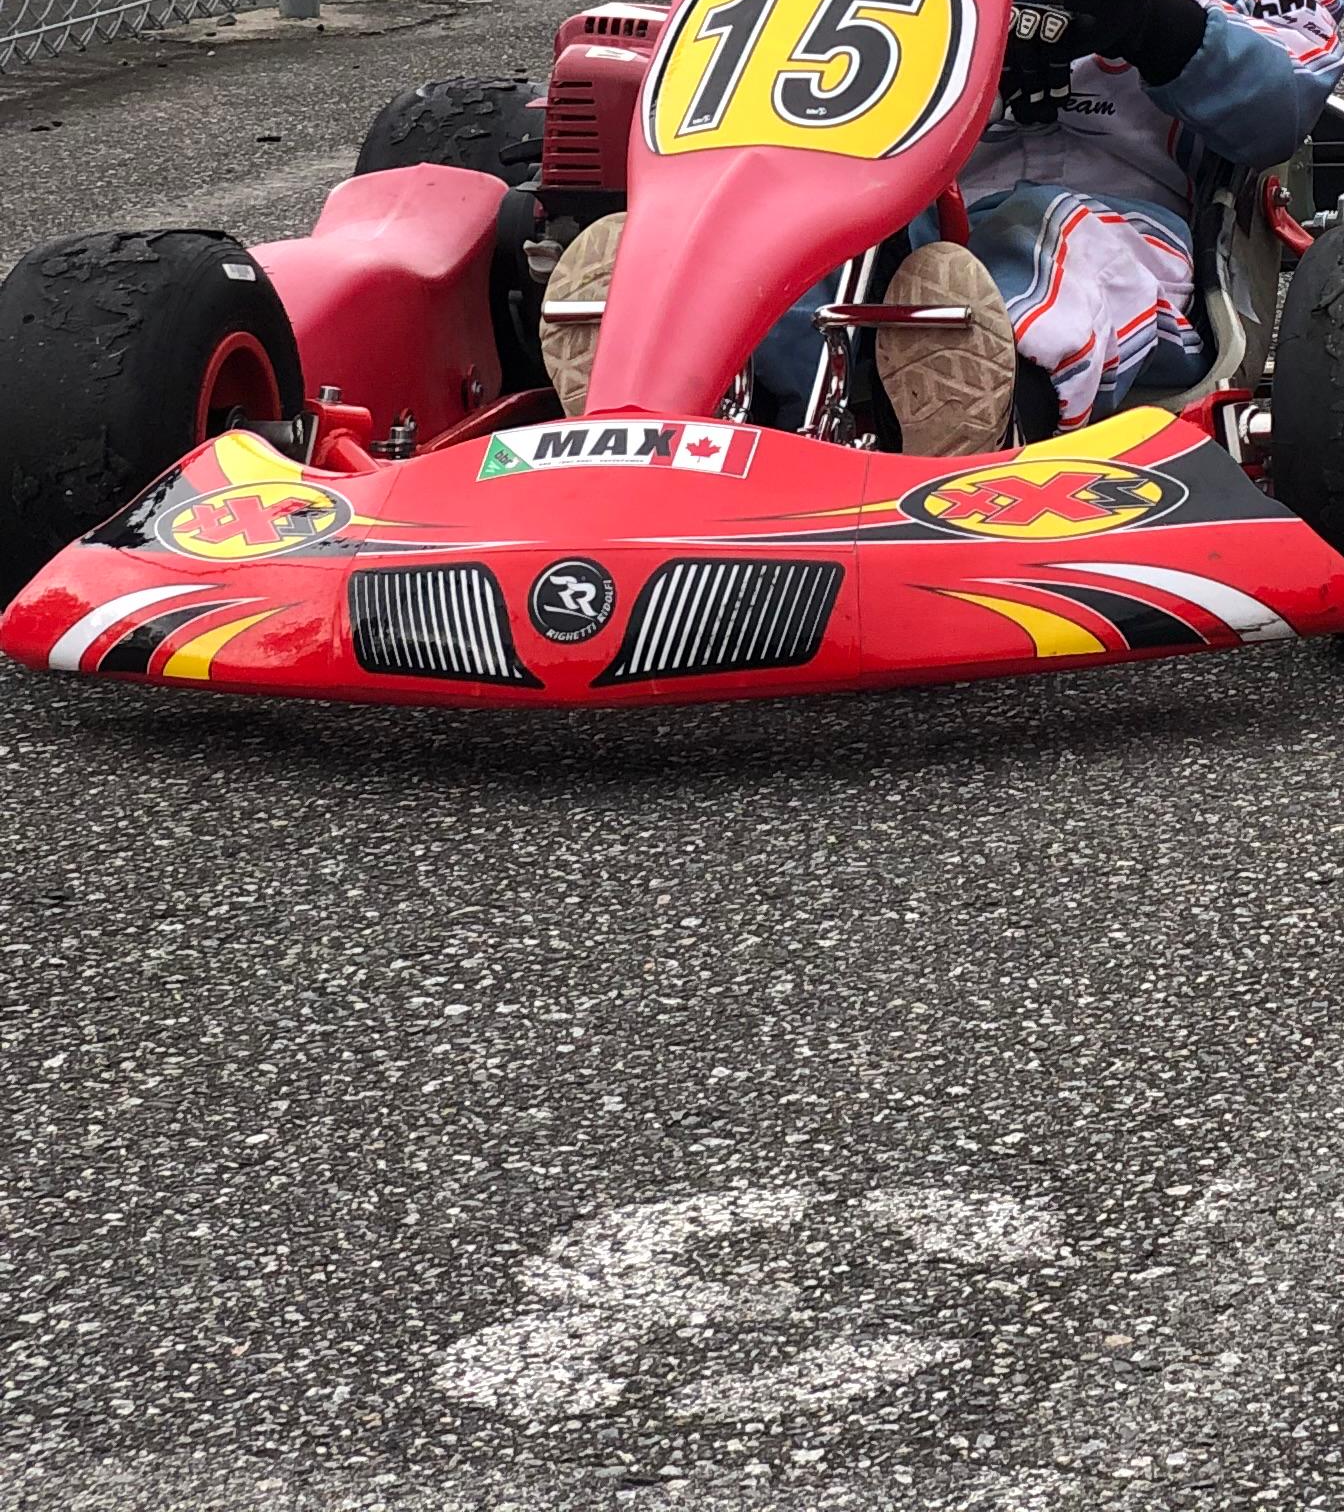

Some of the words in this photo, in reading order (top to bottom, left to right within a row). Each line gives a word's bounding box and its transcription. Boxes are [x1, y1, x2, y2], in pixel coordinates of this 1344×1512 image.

[1064, 99, 1116, 116] eam
[533, 428, 676, 460] MAX
[546, 622, 597, 641] RIGHETTI
[597, 579, 614, 624] RIDOLFI
